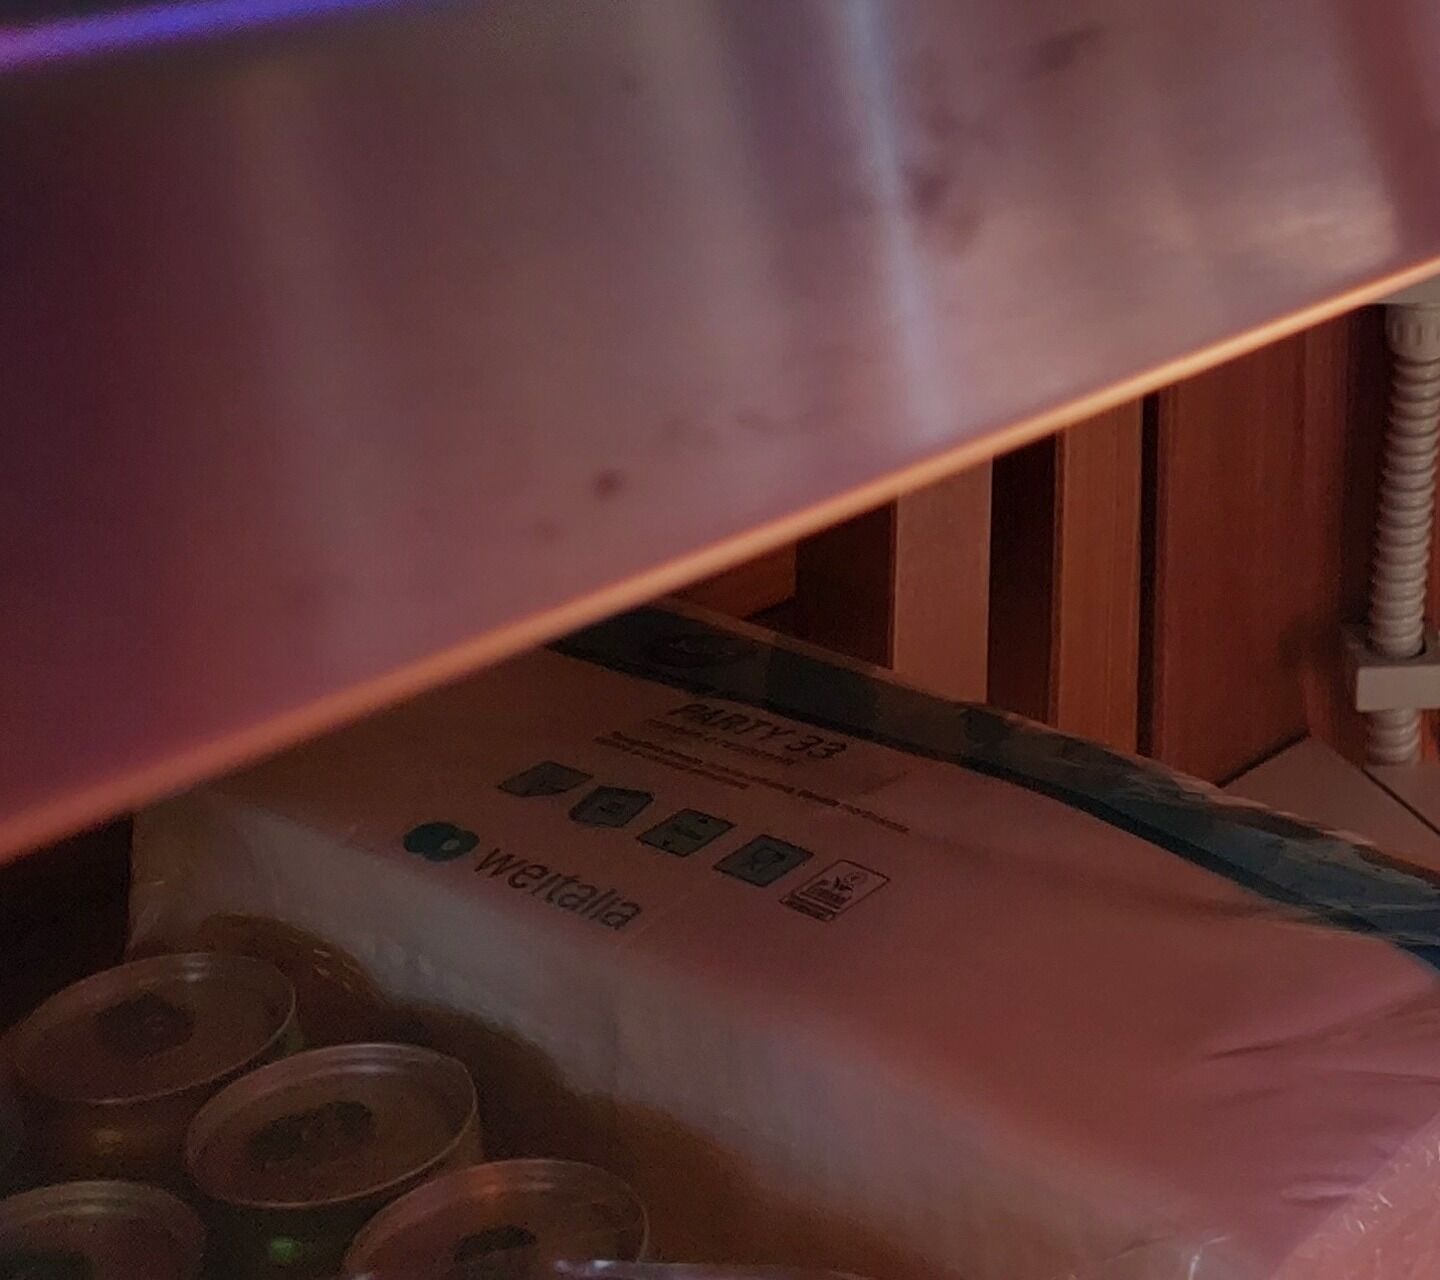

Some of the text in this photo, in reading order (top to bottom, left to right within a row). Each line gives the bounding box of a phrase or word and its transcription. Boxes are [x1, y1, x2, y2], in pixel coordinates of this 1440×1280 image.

[667, 704, 796, 740] PARTY
[785, 735, 847, 759] 33
[473, 846, 643, 931] weitalia
